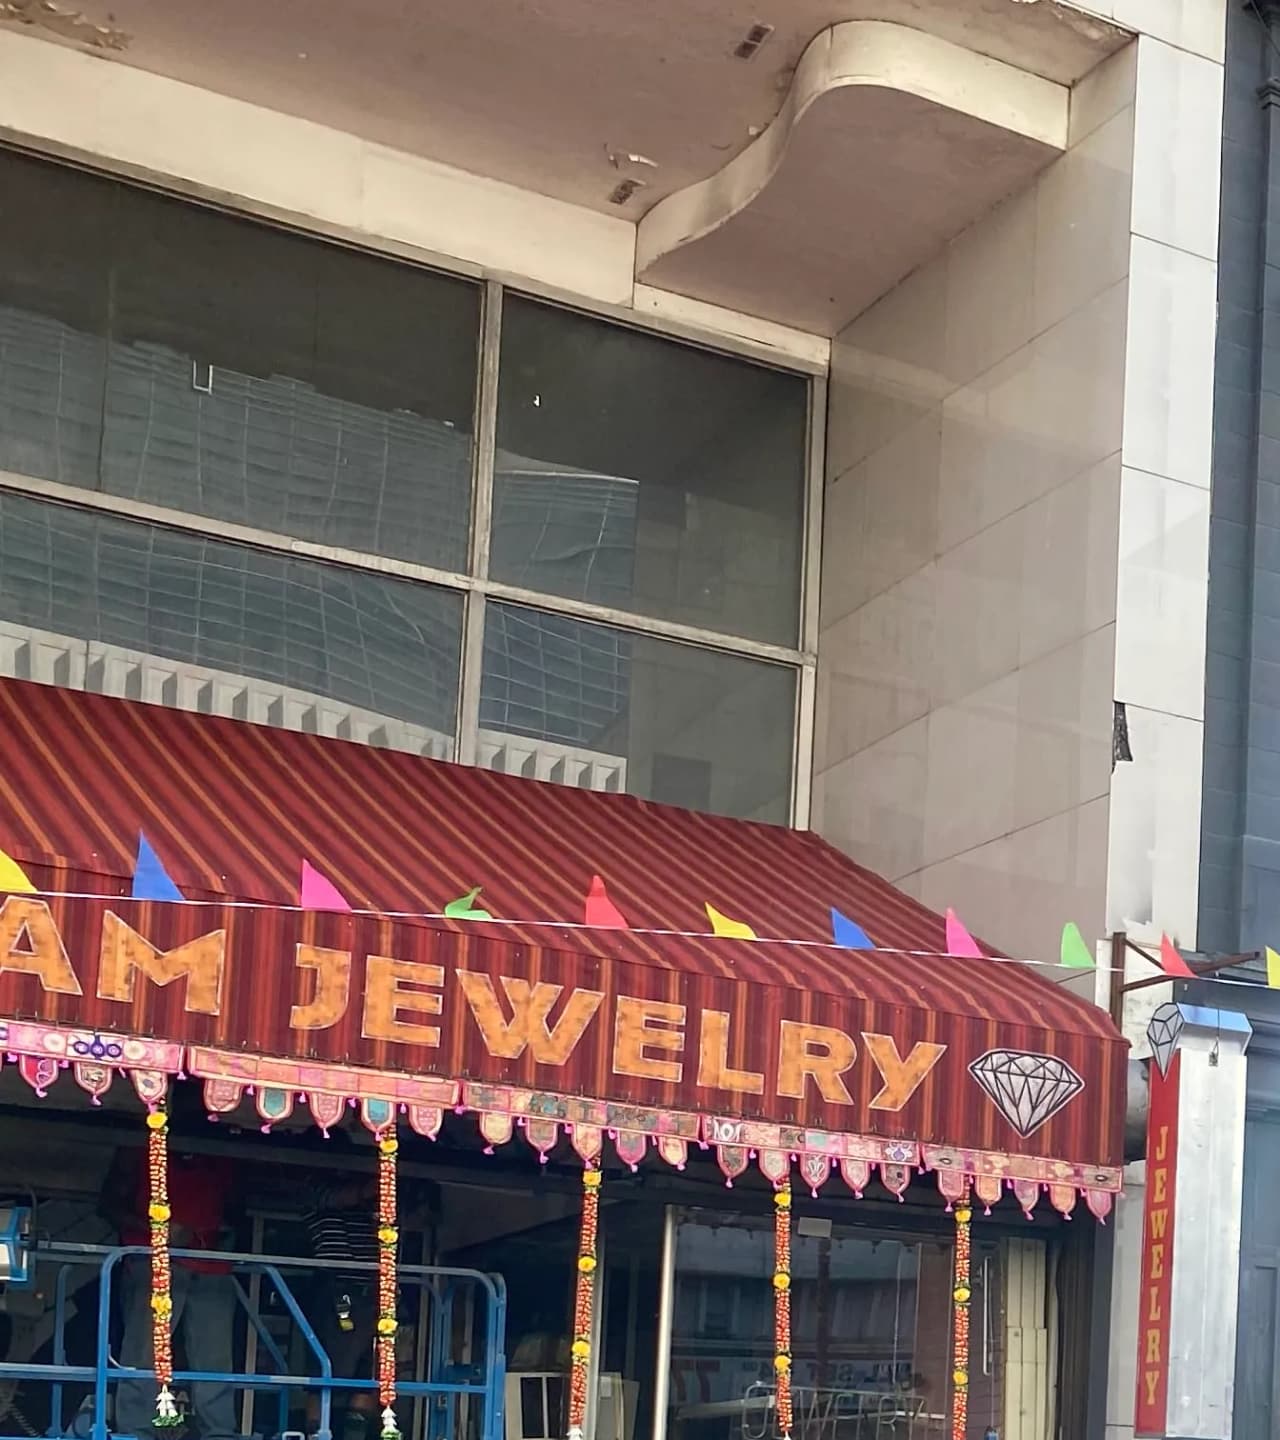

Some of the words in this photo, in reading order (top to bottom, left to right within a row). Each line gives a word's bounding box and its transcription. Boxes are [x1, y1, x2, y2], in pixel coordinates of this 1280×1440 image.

[0, 893, 226, 1016] AM
[288, 941, 949, 1113] JEWELRY
[1145, 1125, 1169, 1406] JEWELRY
